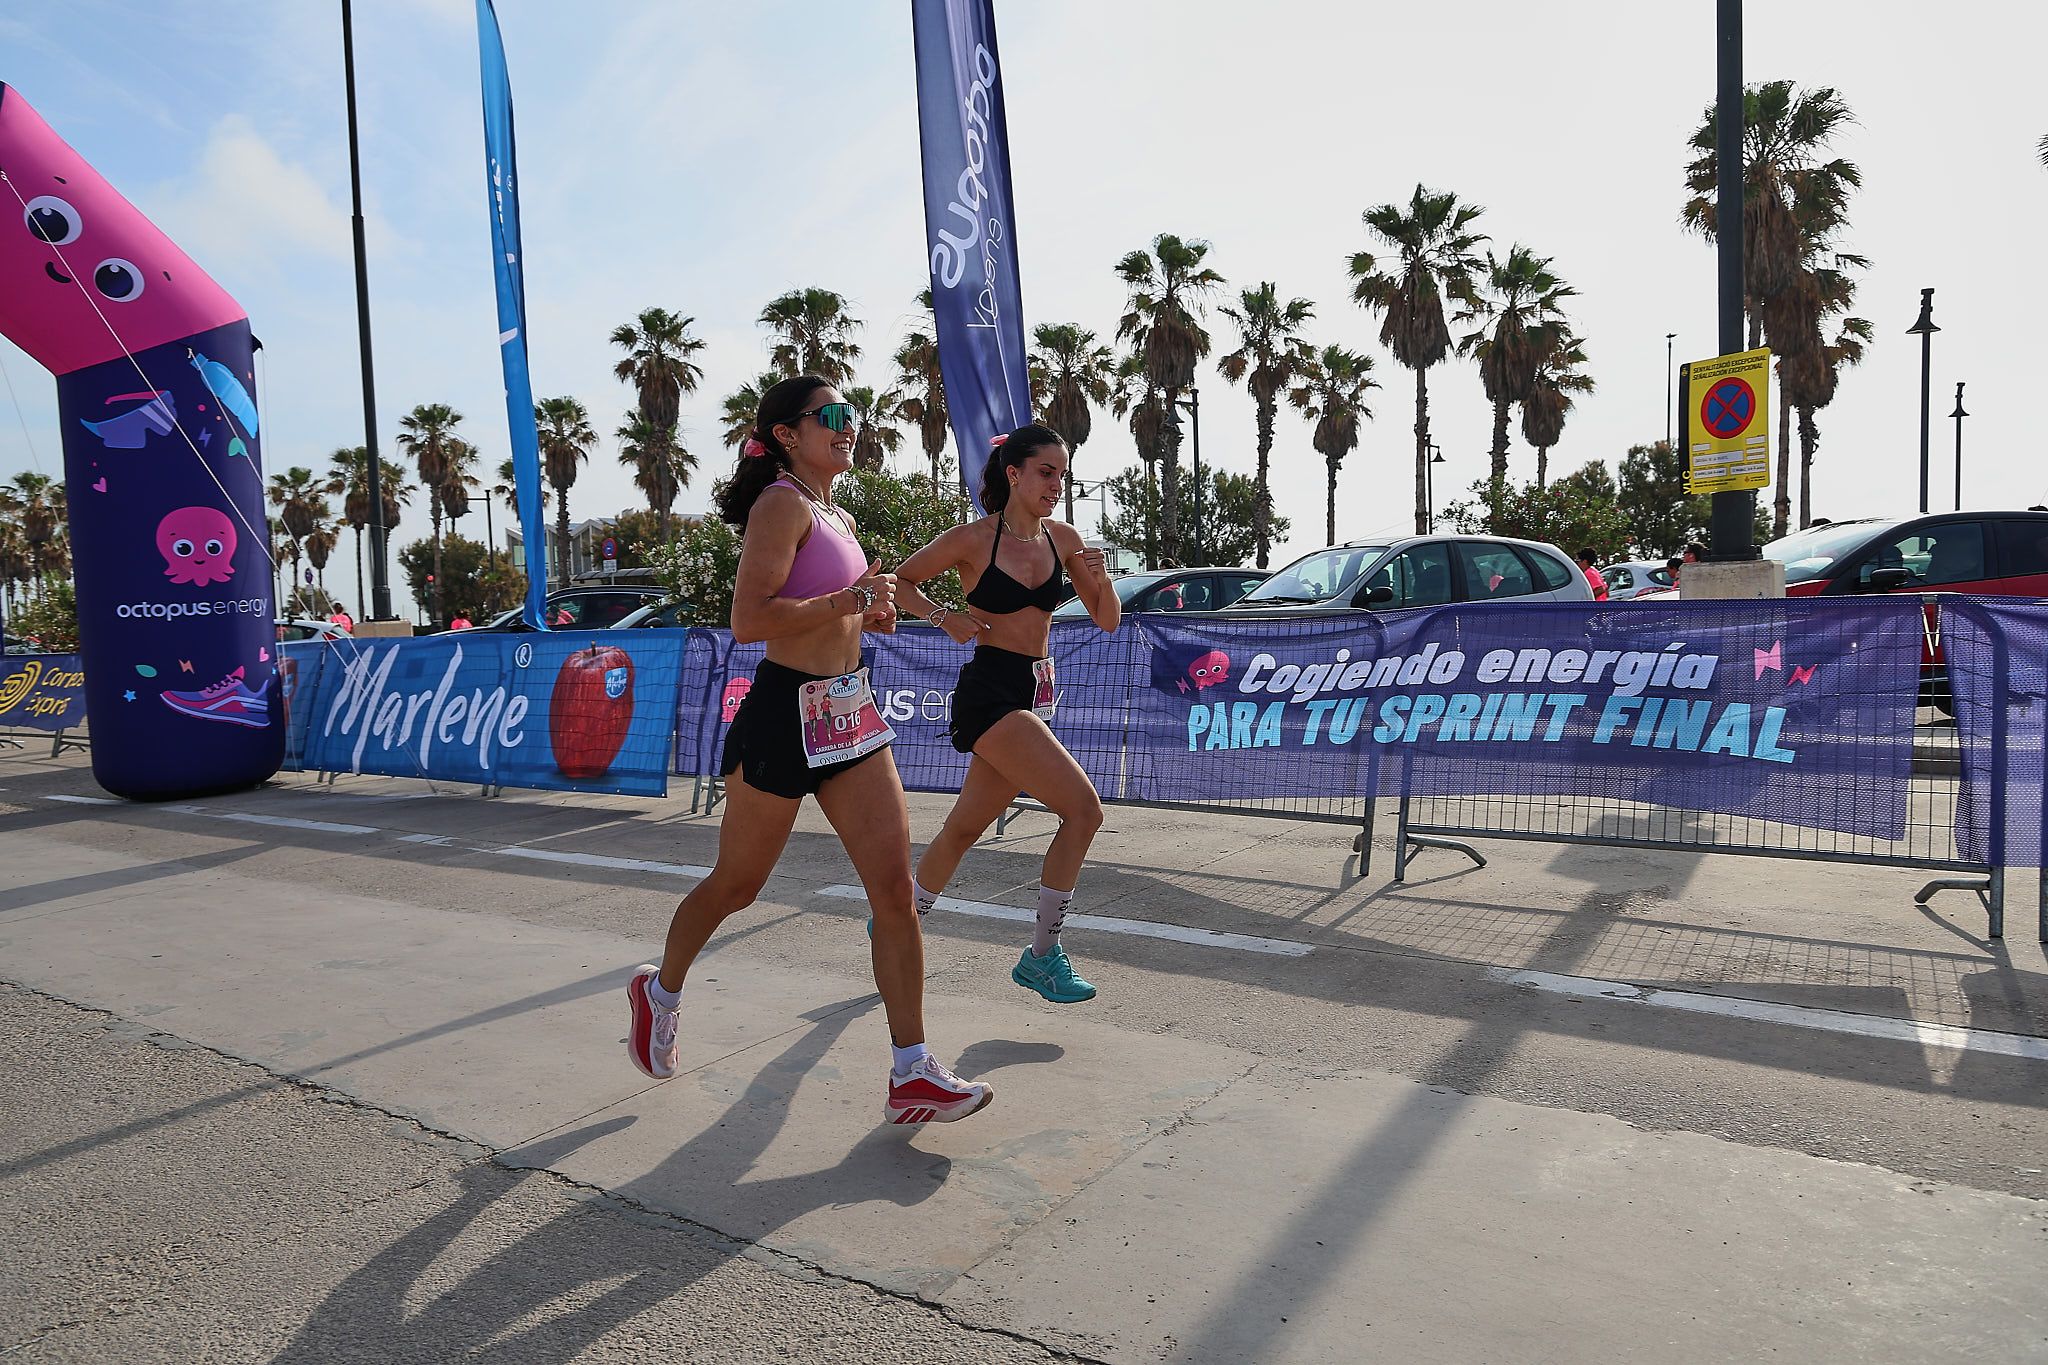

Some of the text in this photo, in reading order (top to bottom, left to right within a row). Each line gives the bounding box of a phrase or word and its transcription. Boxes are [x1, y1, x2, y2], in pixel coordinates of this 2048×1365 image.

[116, 598, 268, 621] octopus energy
[1238, 642, 1719, 703] Cogiendo energía
[324, 641, 529, 776] Marlene
[834, 710, 861, 731] 016
[1187, 693, 1796, 764] PARA TU SPRINT FINAL
[815, 743, 837, 754] CARRERA
[819, 753, 849, 765] OYSHO
